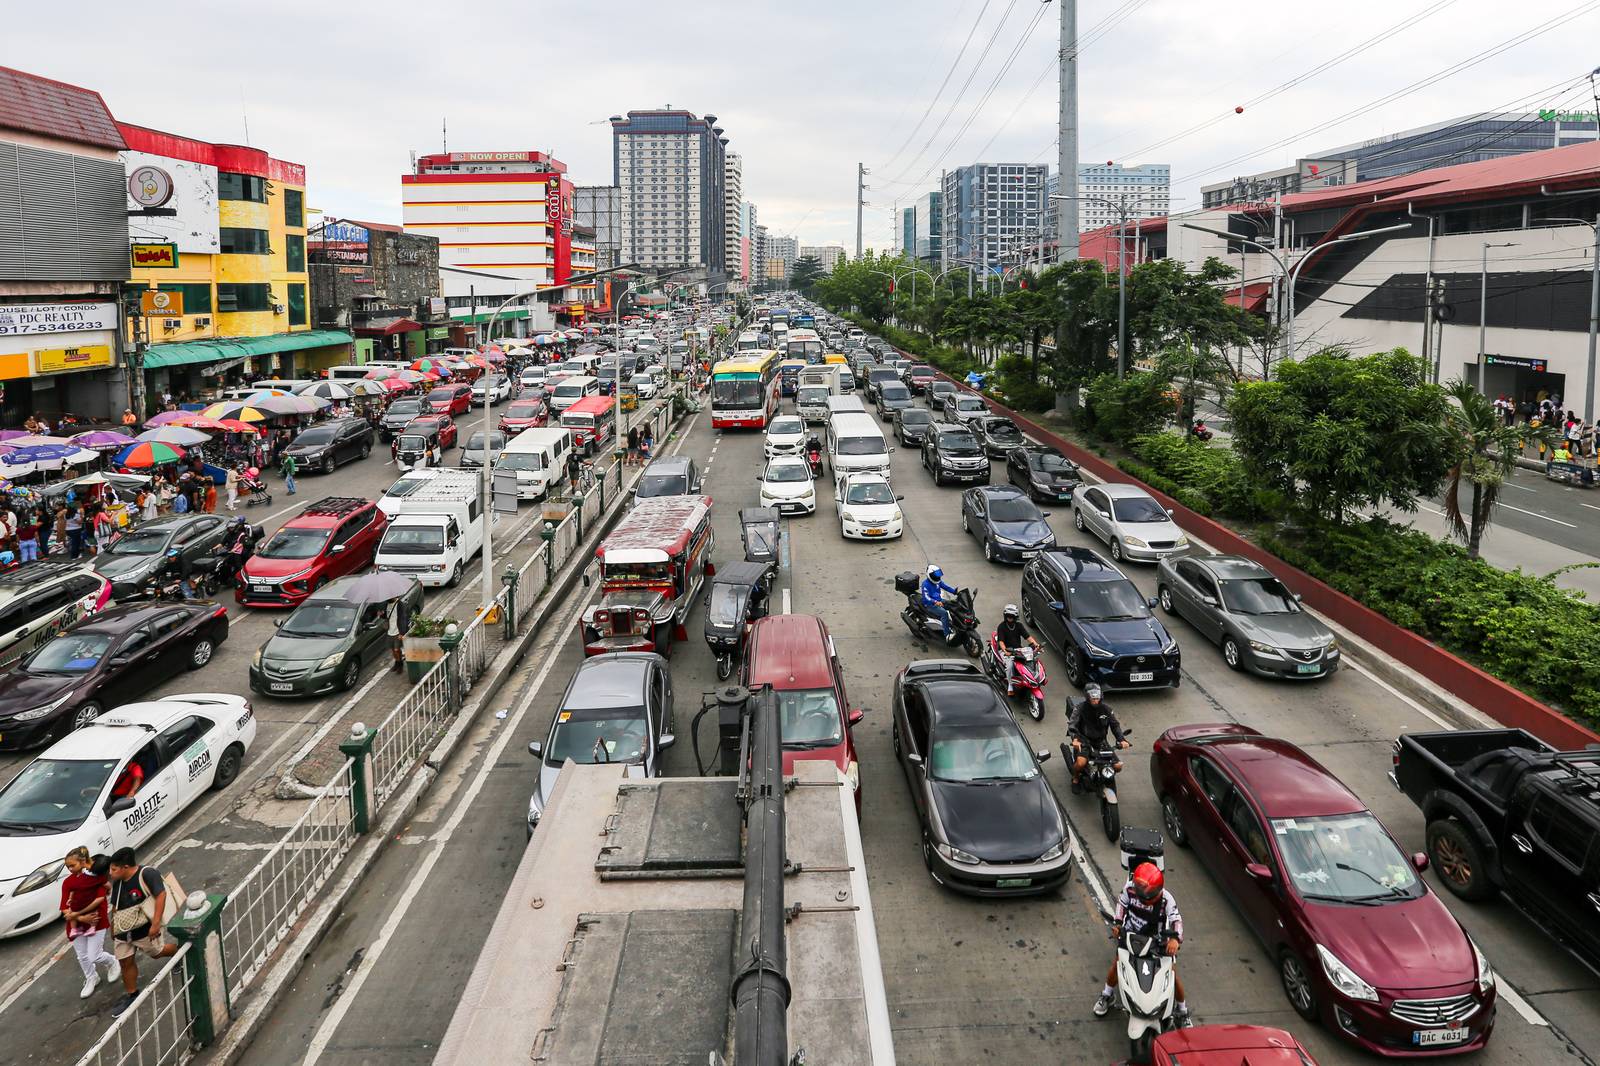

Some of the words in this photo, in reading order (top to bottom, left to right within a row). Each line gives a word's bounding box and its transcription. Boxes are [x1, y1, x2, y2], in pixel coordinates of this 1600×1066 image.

[469, 153, 493, 161] NOW
[495, 152, 526, 160] OPEN!
[36, 305, 56, 313] LOT
[64, 304, 97, 312] CONDO
[19, 313, 42, 324] PDC
[45, 311, 85, 323] REALTY
[188, 749, 211, 777] AIRCON
[122, 791, 162, 831] TORLETTE
[1421, 1033, 1437, 1043] DAC
[1441, 1032, 1461, 1041] 4031
